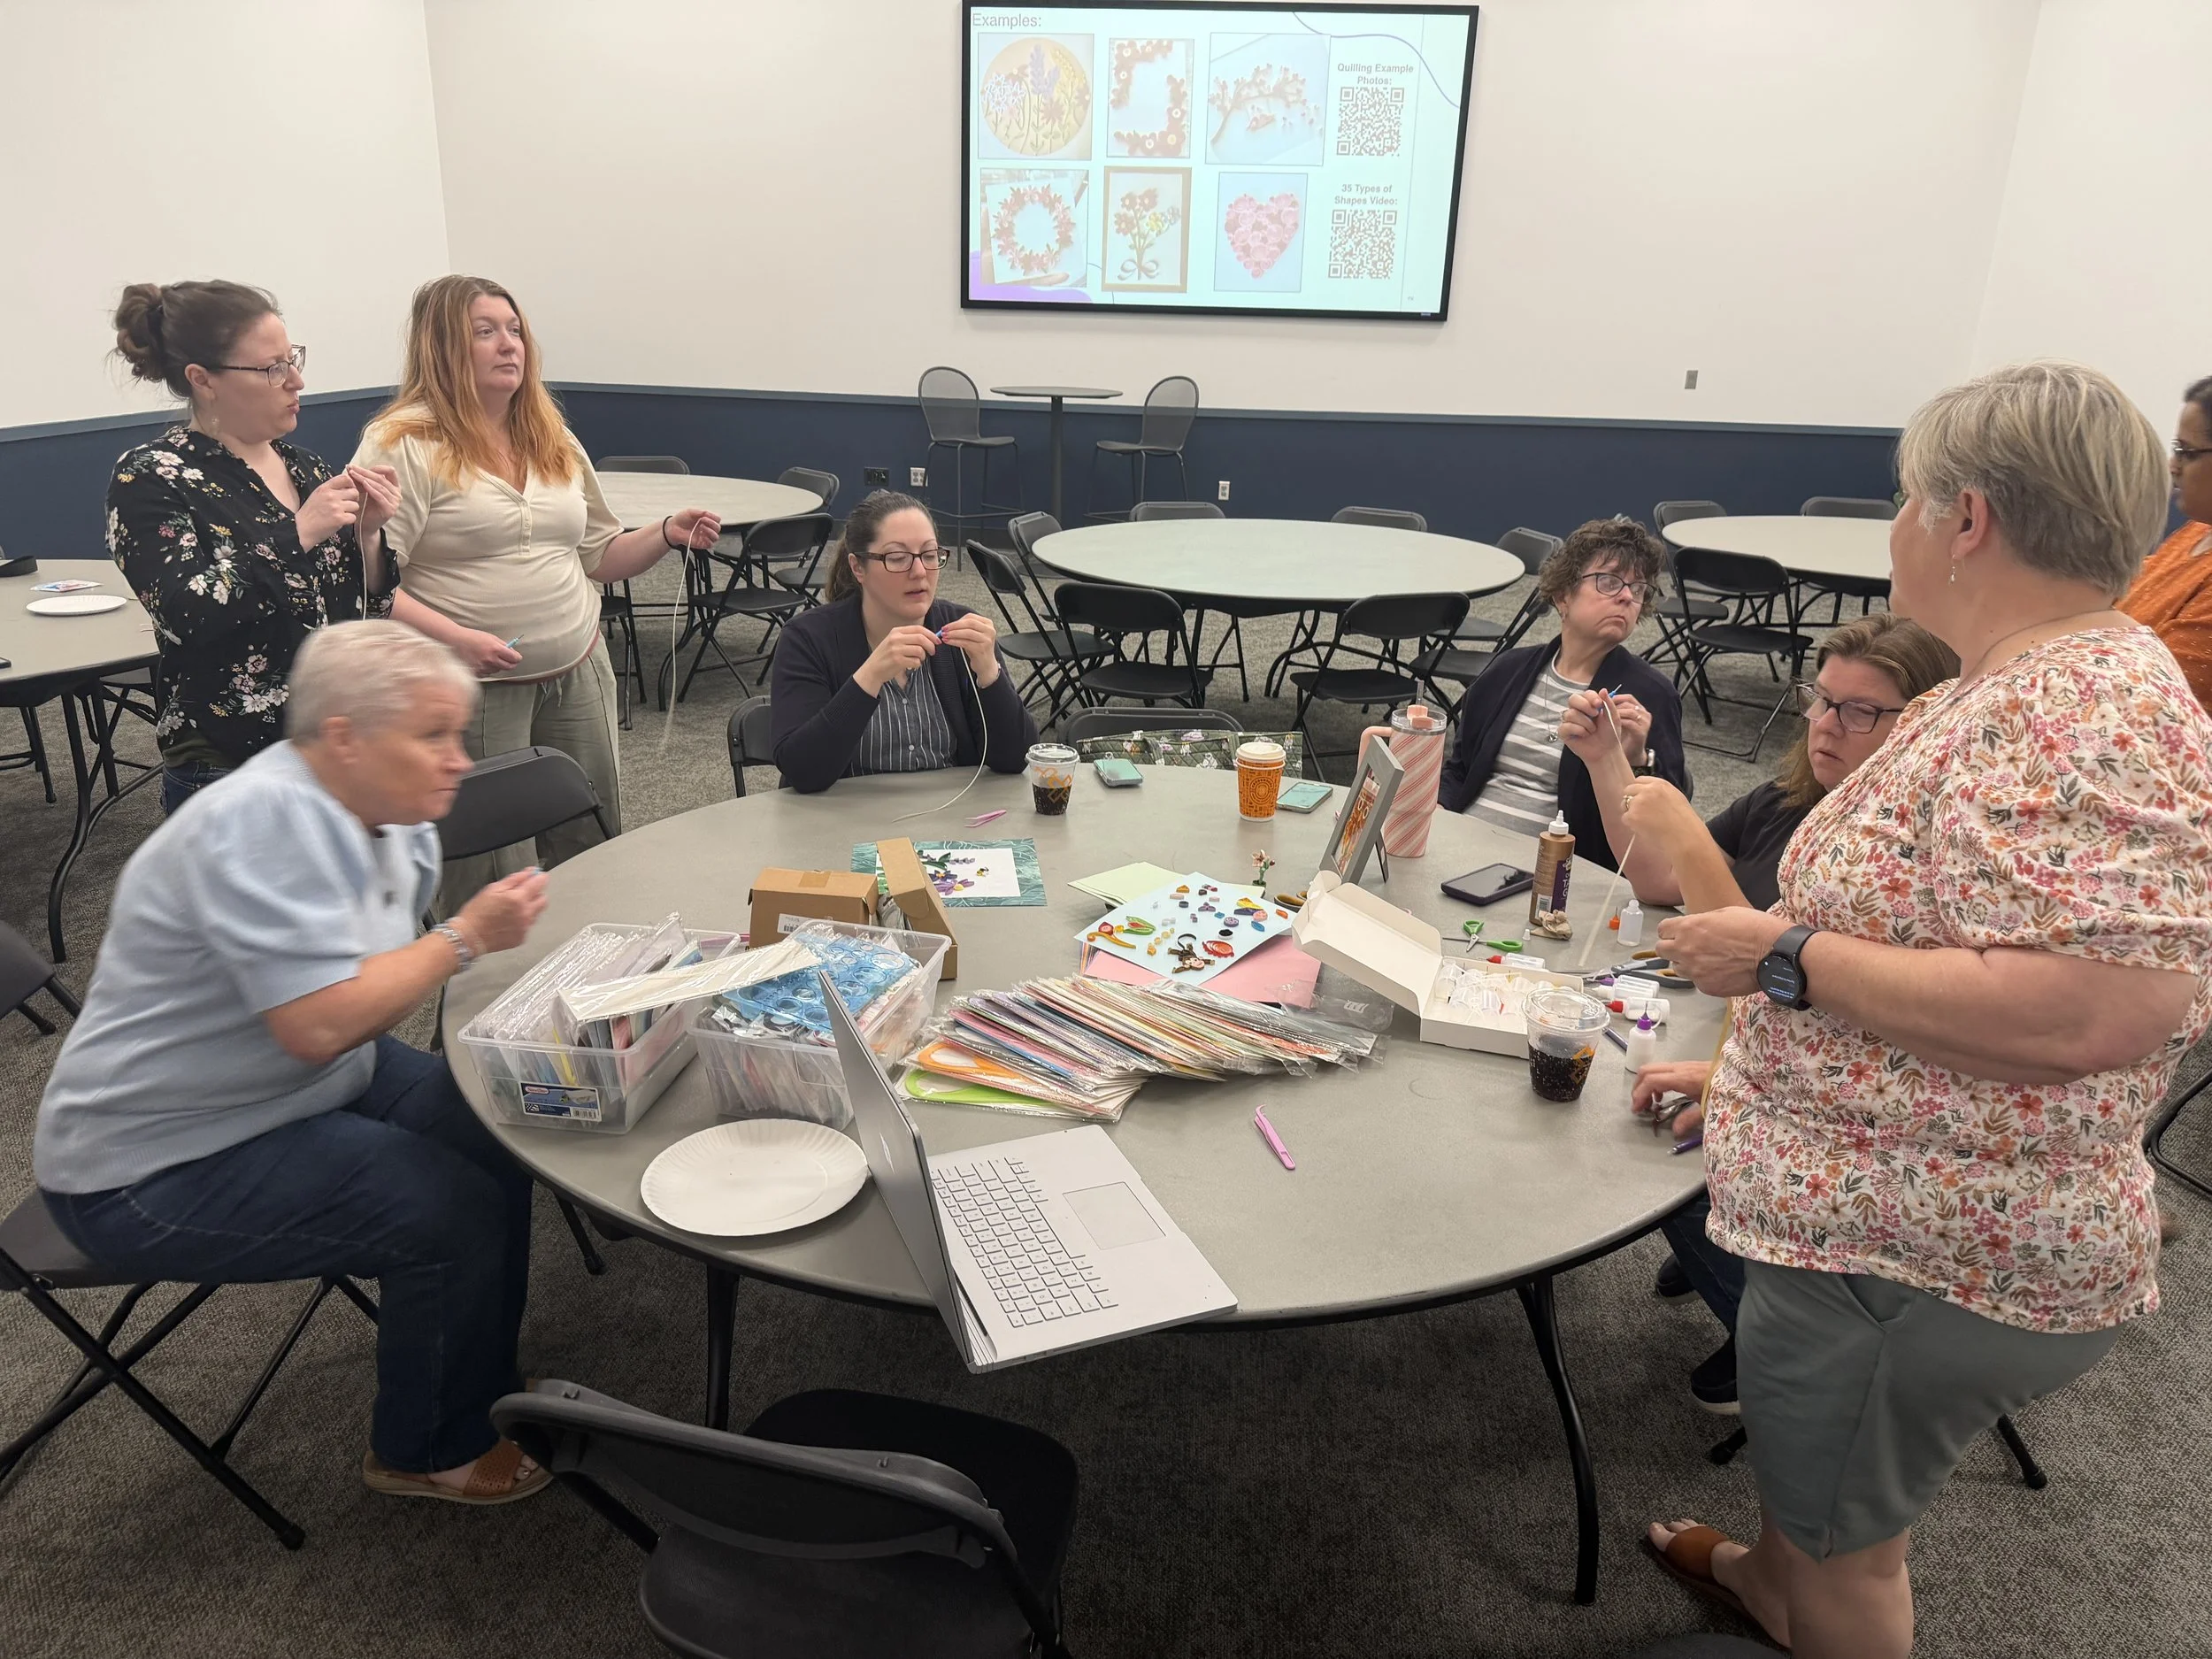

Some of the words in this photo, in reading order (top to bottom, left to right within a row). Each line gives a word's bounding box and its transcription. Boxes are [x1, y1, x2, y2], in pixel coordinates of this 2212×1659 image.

[972, 12, 1041, 30] Examples:
[1337, 63, 1372, 74] Quilling
[1375, 64, 1414, 74] Example
[1357, 75, 1393, 85] Photos:
[1341, 183, 1352, 193] 35
[1355, 184, 1380, 195] Types
[1383, 184, 1393, 193] of
[1334, 195, 1367, 206] Shapes
[1370, 196, 1398, 205] Video:
